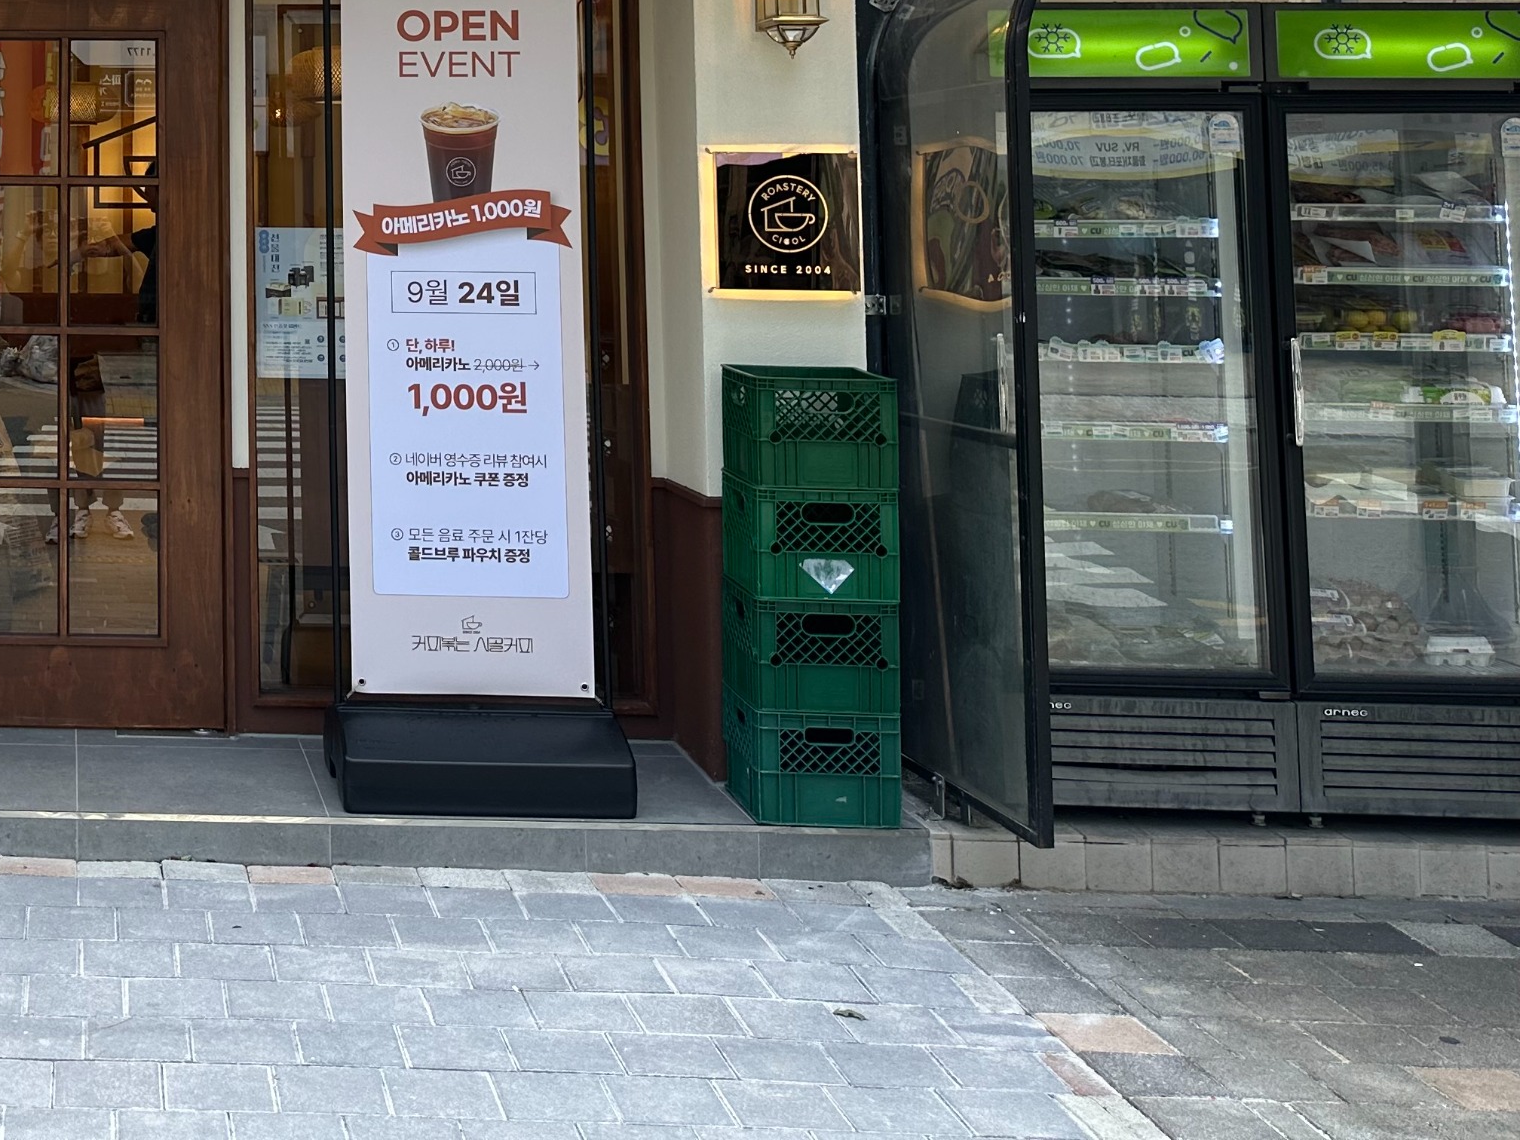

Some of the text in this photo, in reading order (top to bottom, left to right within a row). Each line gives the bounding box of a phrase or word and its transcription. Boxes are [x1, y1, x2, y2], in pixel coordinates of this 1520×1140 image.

[396, 9, 520, 42] OPEN
[398, 51, 521, 78] EVENT
[761, 182, 816, 203] ROASTERY
[381, 199, 542, 235] 아메리카노 1,000원
[745, 264, 831, 275] SINCE 2004
[407, 279, 520, 306] 9월 24일
[406, 338, 422, 354] 단,
[425, 338, 455, 353] 하루!
[406, 357, 523, 373] 아메리카노 2,000원
[408, 381, 527, 416] 1,000원
[405, 452, 442, 467] 네이버
[444, 452, 481, 468] 영수증
[484, 453, 509, 468] 리뷰
[510, 454, 547, 469] 참여시
[406, 471, 529, 488] 아메리카노 쿠폰 증정
[408, 528, 434, 542] 모든
[438, 528, 464, 543] 음료
[468, 528, 495, 543] 주문
[498, 529, 511, 544] 시
[515, 529, 548, 545] 1잔당
[408, 546, 530, 563] 콜드브루 파우치 증정
